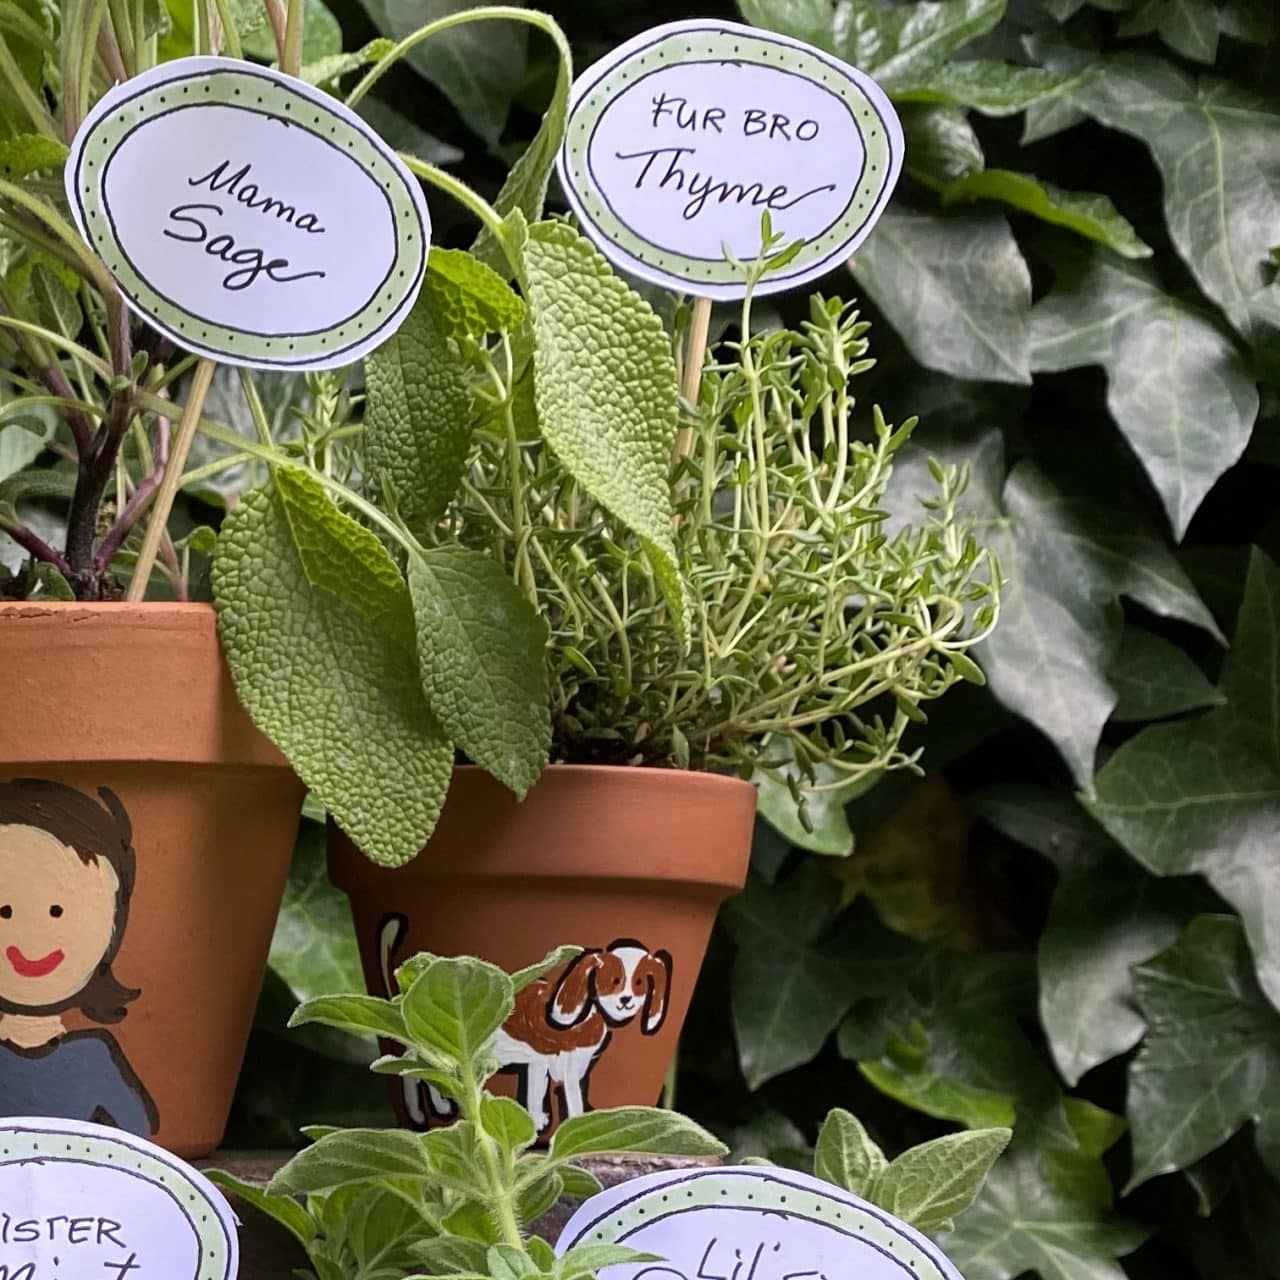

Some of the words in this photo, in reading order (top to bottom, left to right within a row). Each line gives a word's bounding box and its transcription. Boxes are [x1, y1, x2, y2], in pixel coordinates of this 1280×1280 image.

[652, 92, 727, 133] FUR
[743, 109, 820, 142] BRO
[188, 159, 326, 234] Mama
[615, 148, 837, 220] Thyme
[163, 203, 326, 291] Sage
